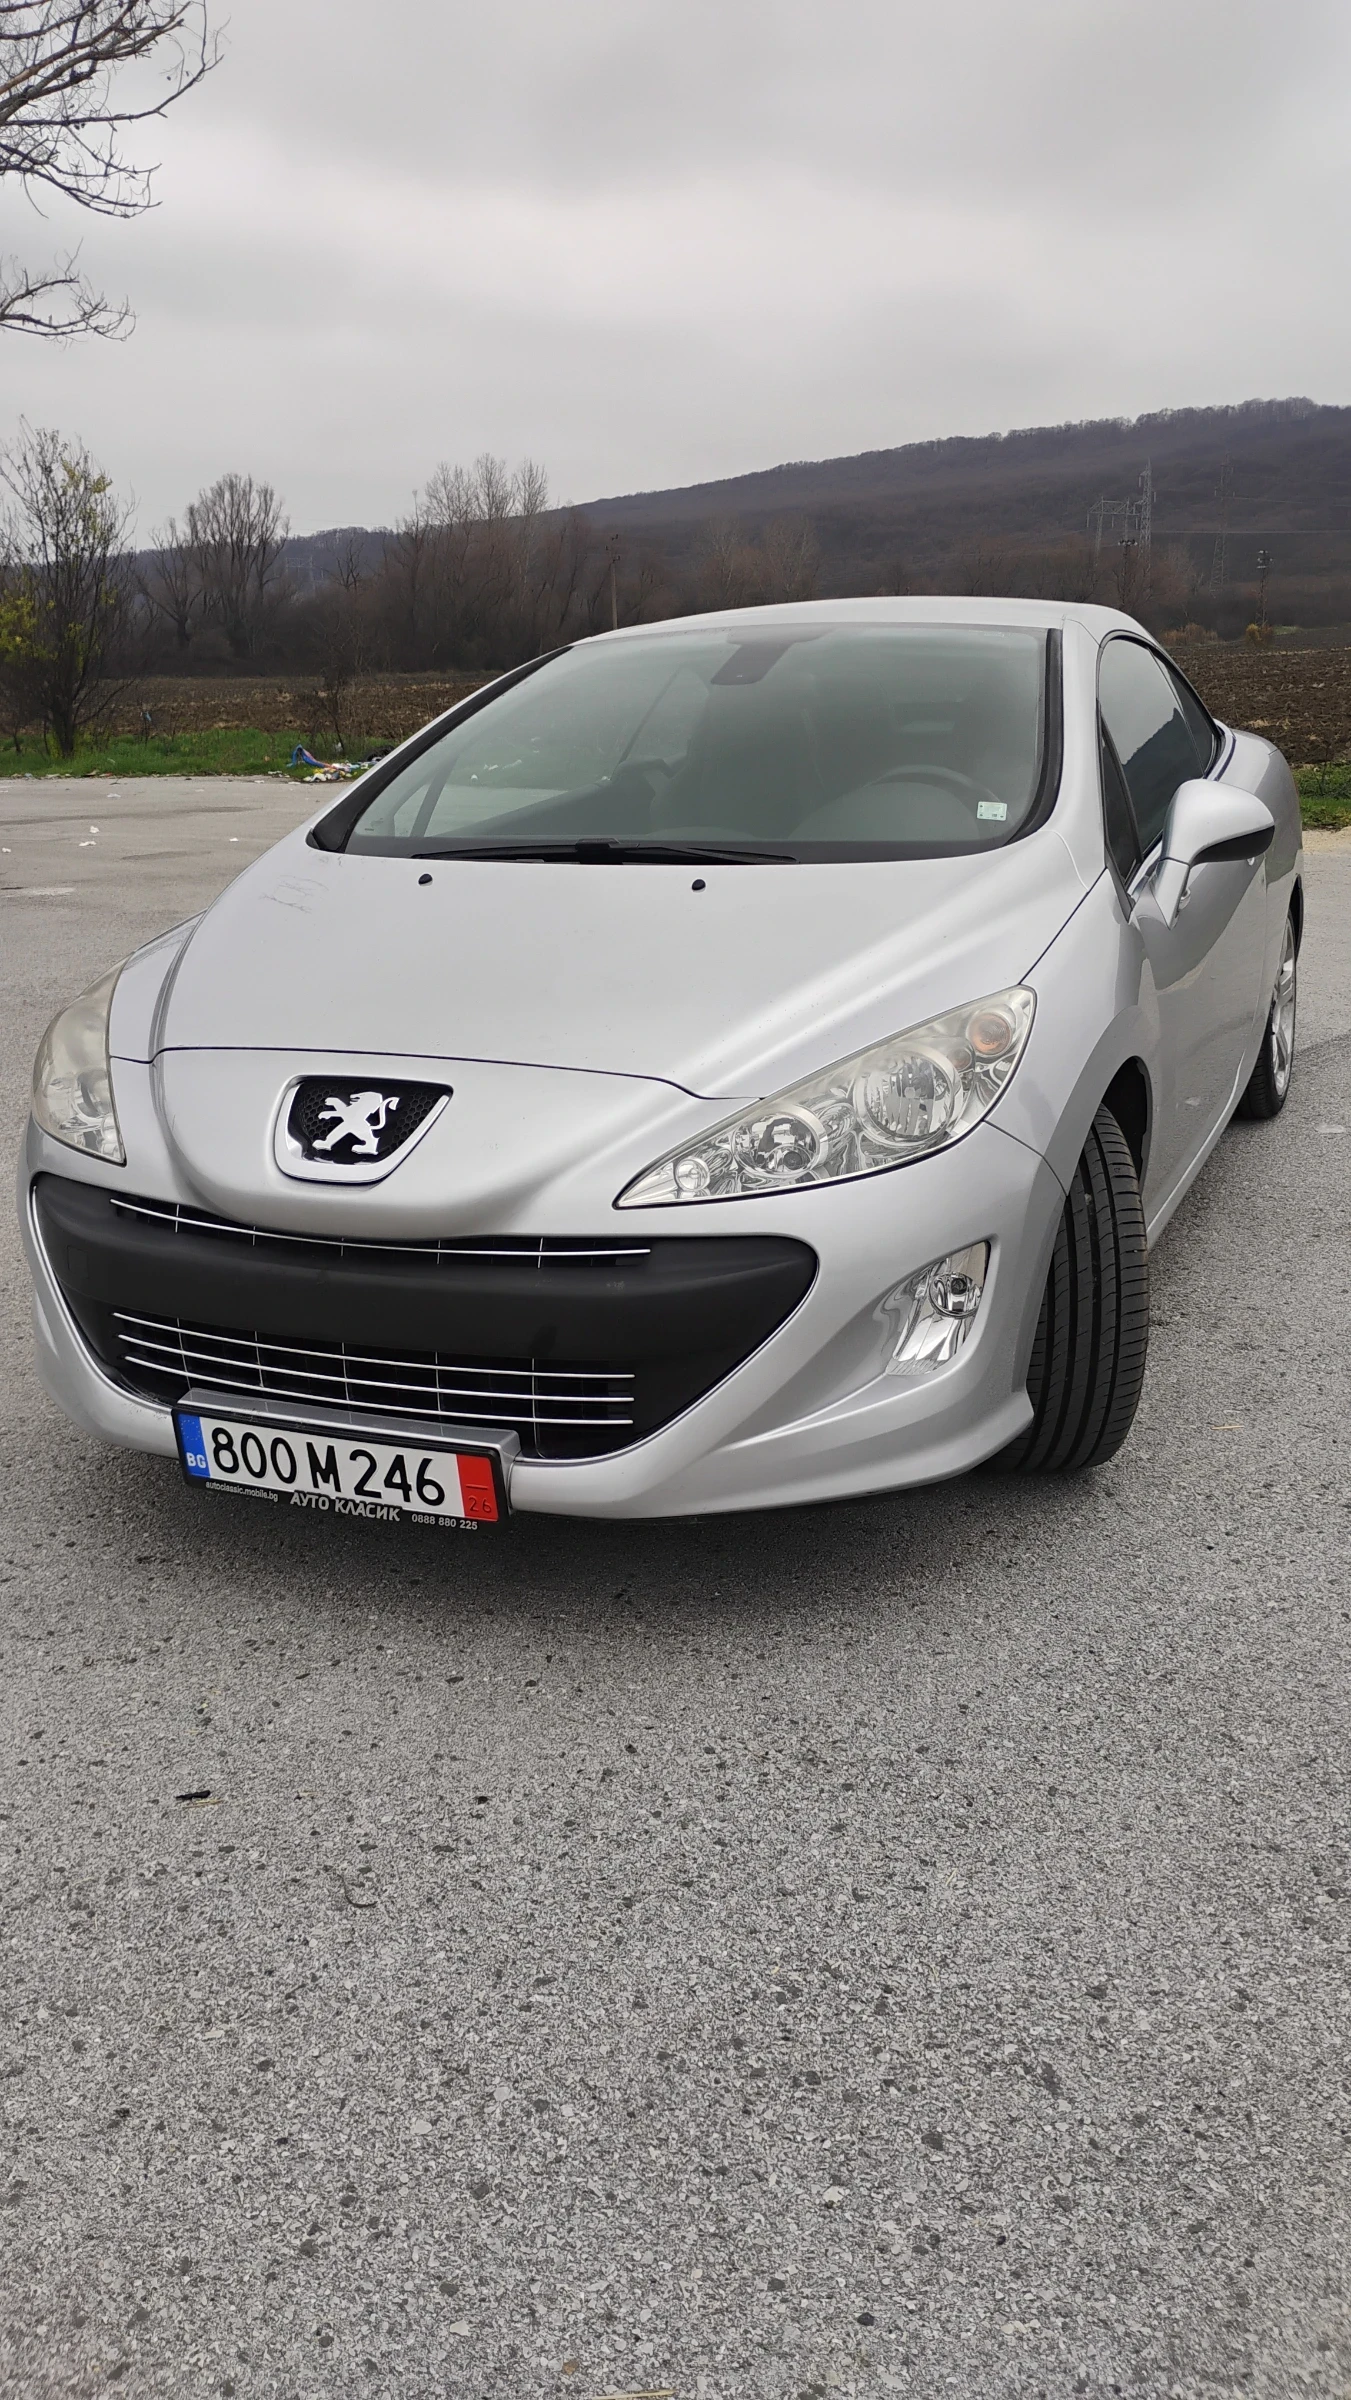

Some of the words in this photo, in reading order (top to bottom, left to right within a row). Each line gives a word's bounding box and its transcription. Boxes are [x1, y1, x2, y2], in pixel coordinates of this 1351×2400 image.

[186, 1451, 207, 1469] BG
[210, 1427, 298, 1484] 800
[306, 1441, 342, 1493] M
[349, 1449, 446, 1506] 246
[205, 1480, 279, 1502] autoclassic.mobile.bg
[290, 1492, 330, 1511] АУТО
[334, 1499, 401, 1522] КЛАСИК
[467, 1495, 492, 1513] 26
[411, 1513, 436, 1525] 0888
[438, 1517, 457, 1528] 880
[459, 1519, 478, 1530] 225
